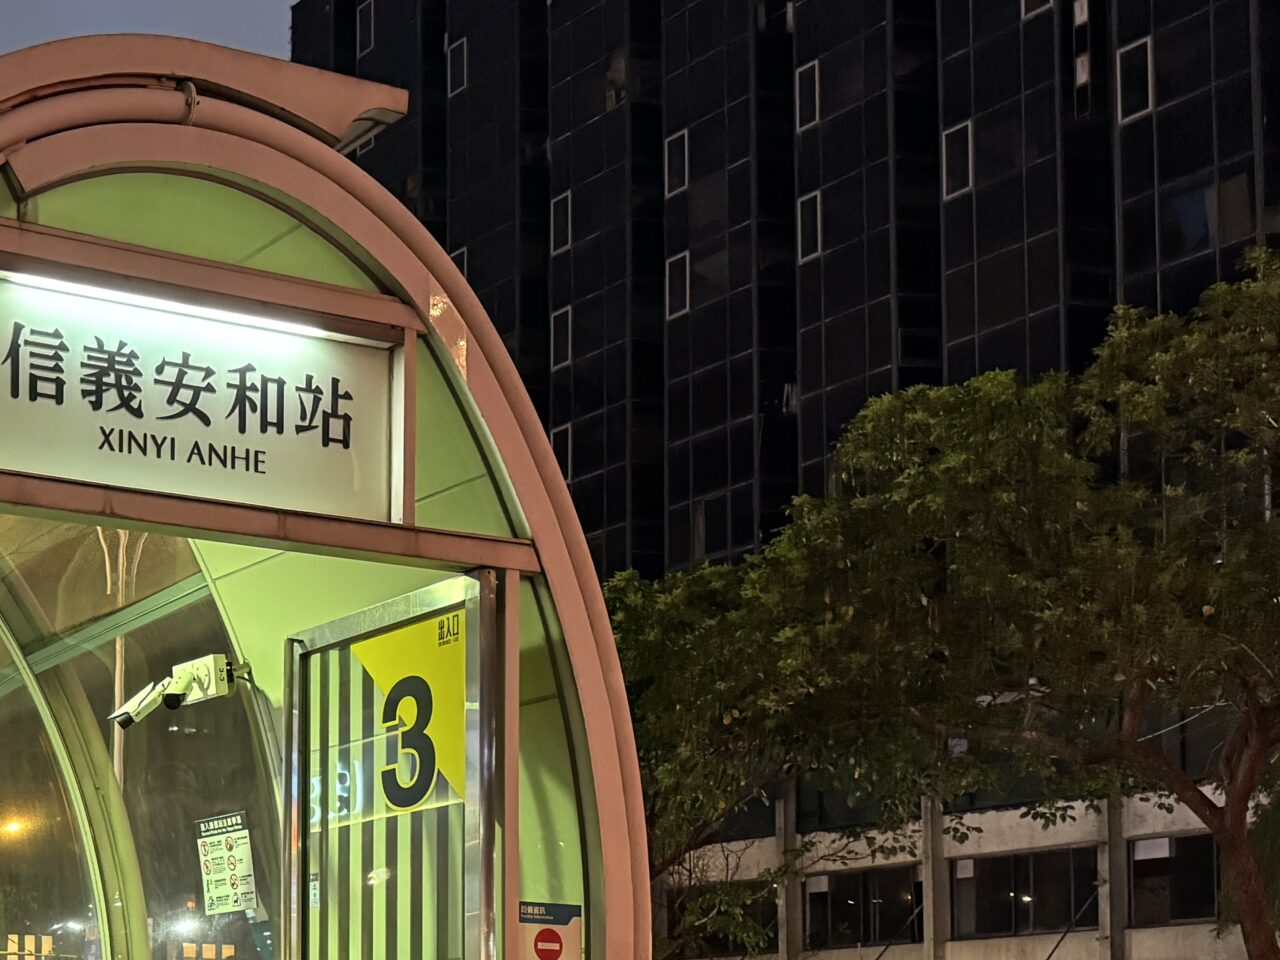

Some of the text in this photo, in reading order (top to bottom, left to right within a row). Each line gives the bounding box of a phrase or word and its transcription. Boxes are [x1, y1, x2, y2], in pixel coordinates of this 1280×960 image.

[0, 321, 354, 450] 信義安和站
[98, 426, 267, 474] XINYI ANHE
[438, 614, 459, 641] 出入口
[381, 675, 436, 808] 3
